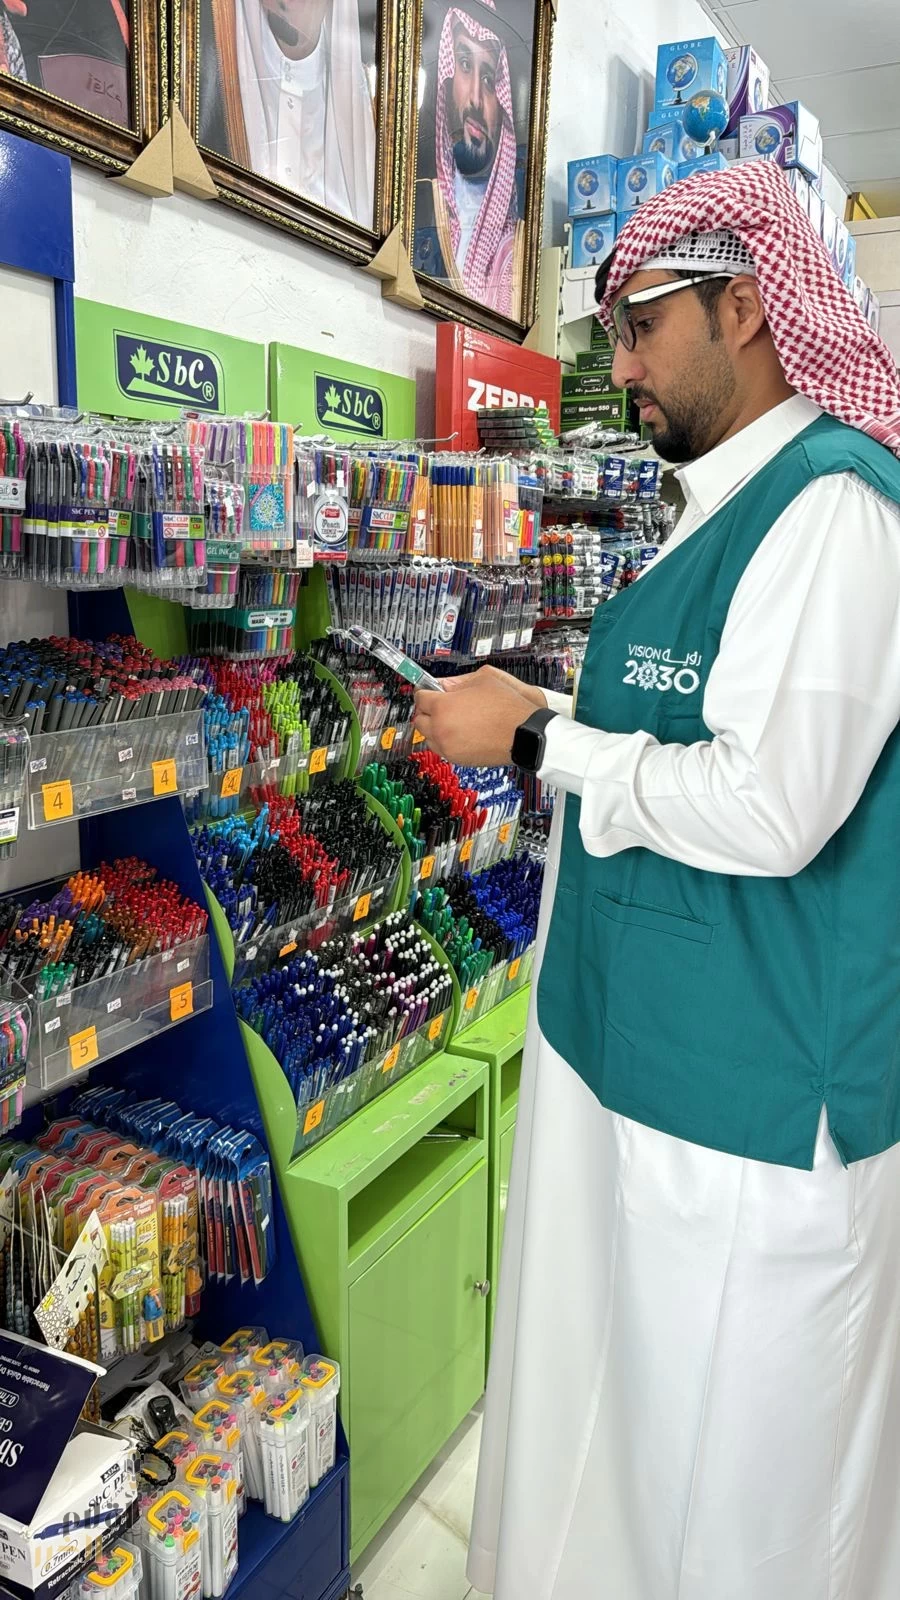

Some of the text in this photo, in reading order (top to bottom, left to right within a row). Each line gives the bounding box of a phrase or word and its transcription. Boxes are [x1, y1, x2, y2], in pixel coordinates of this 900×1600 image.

[670, 41, 702, 52] GLOBE
[661, 110, 686, 119] GLO
[628, 643, 662, 661] VISION
[161, 769, 169, 786] 4
[52, 791, 63, 810] 4
[181, 992, 188, 1009] 5
[79, 1039, 89, 1058] 5
[6, 1368, 21, 1381] Quick
[22, 1374, 50, 1392] Retractable
[0, 1389, 16, 1406] 0.7m
[0, 1438, 24, 1468] Sb
[47, 1556, 84, 1590] Retractable
